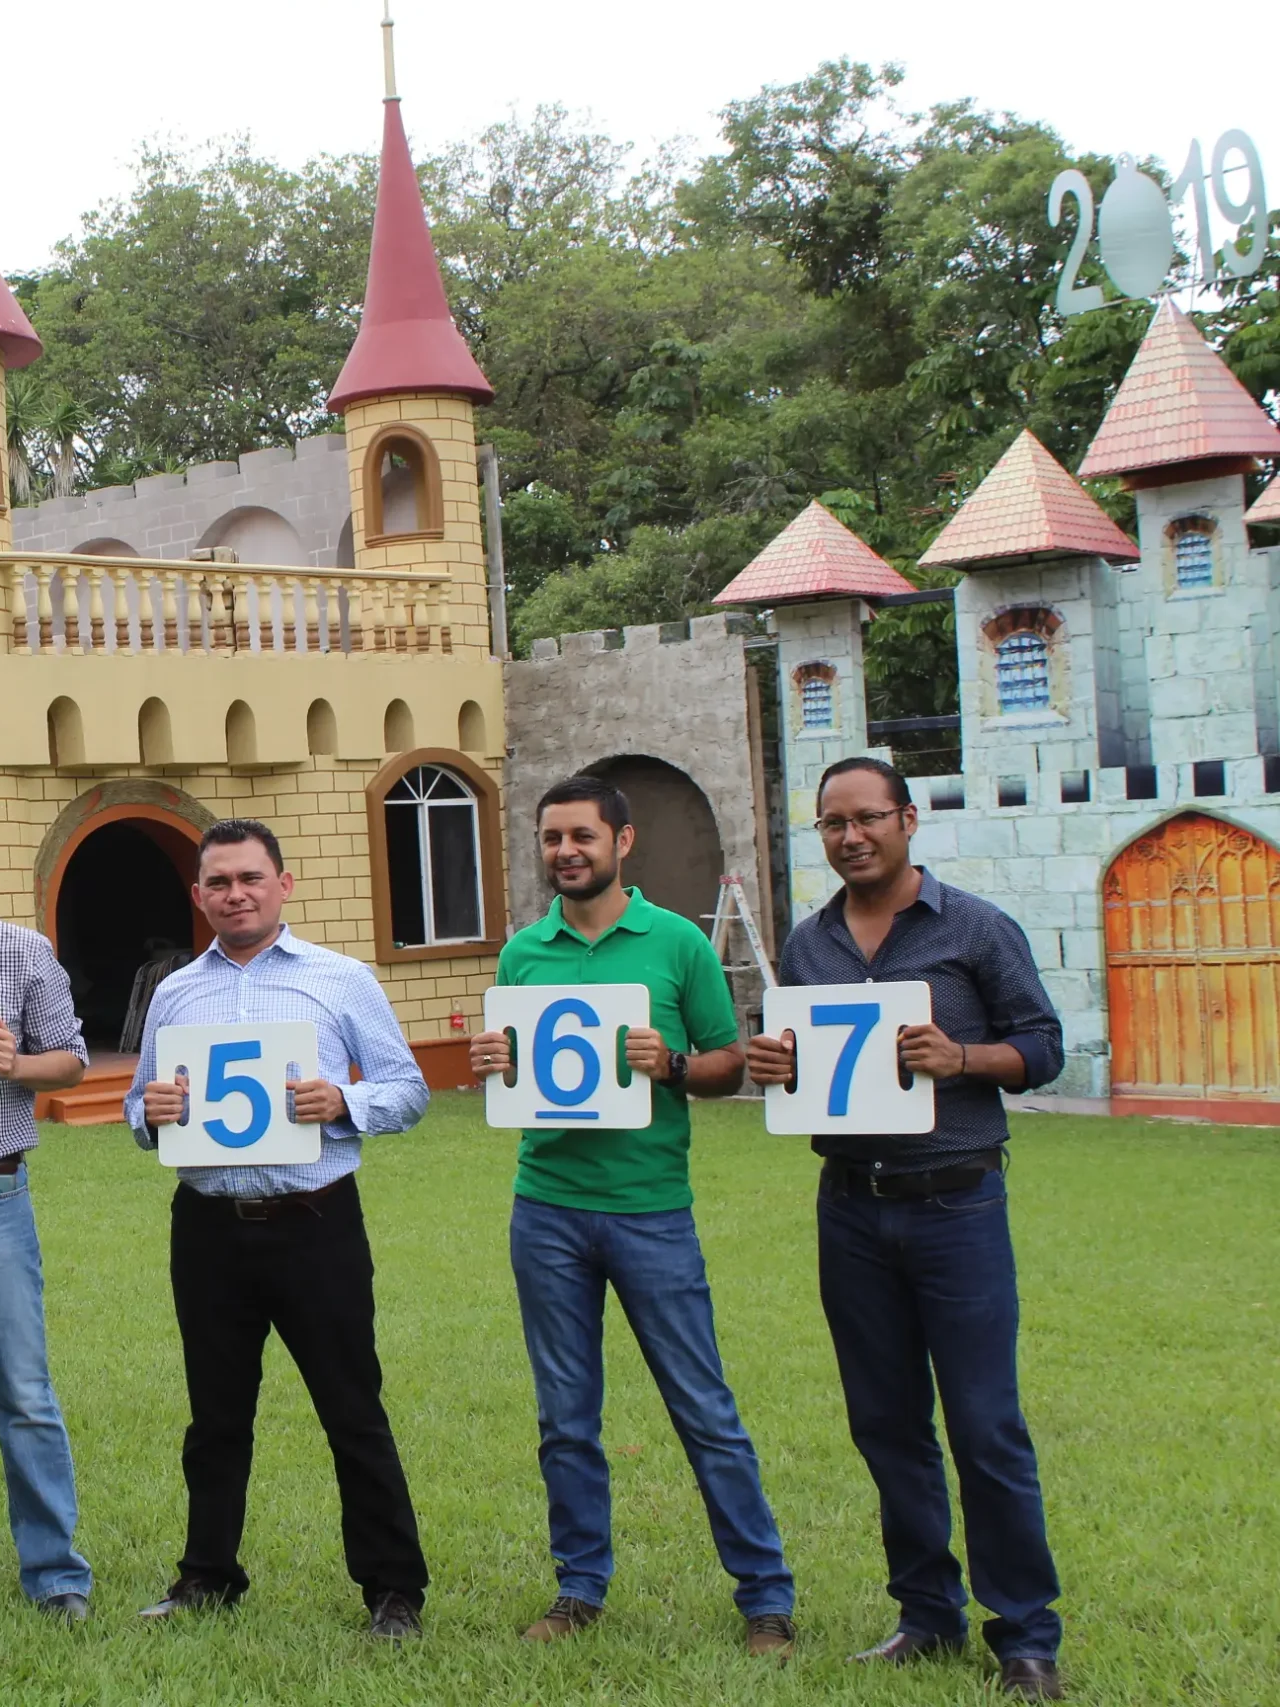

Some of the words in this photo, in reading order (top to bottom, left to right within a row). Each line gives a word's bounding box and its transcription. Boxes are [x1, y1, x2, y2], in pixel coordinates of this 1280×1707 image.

[1048, 128, 1268, 316] 2019
[204, 1041, 271, 1148] 5
[534, 999, 600, 1106] 6
[812, 1003, 880, 1116] 7
